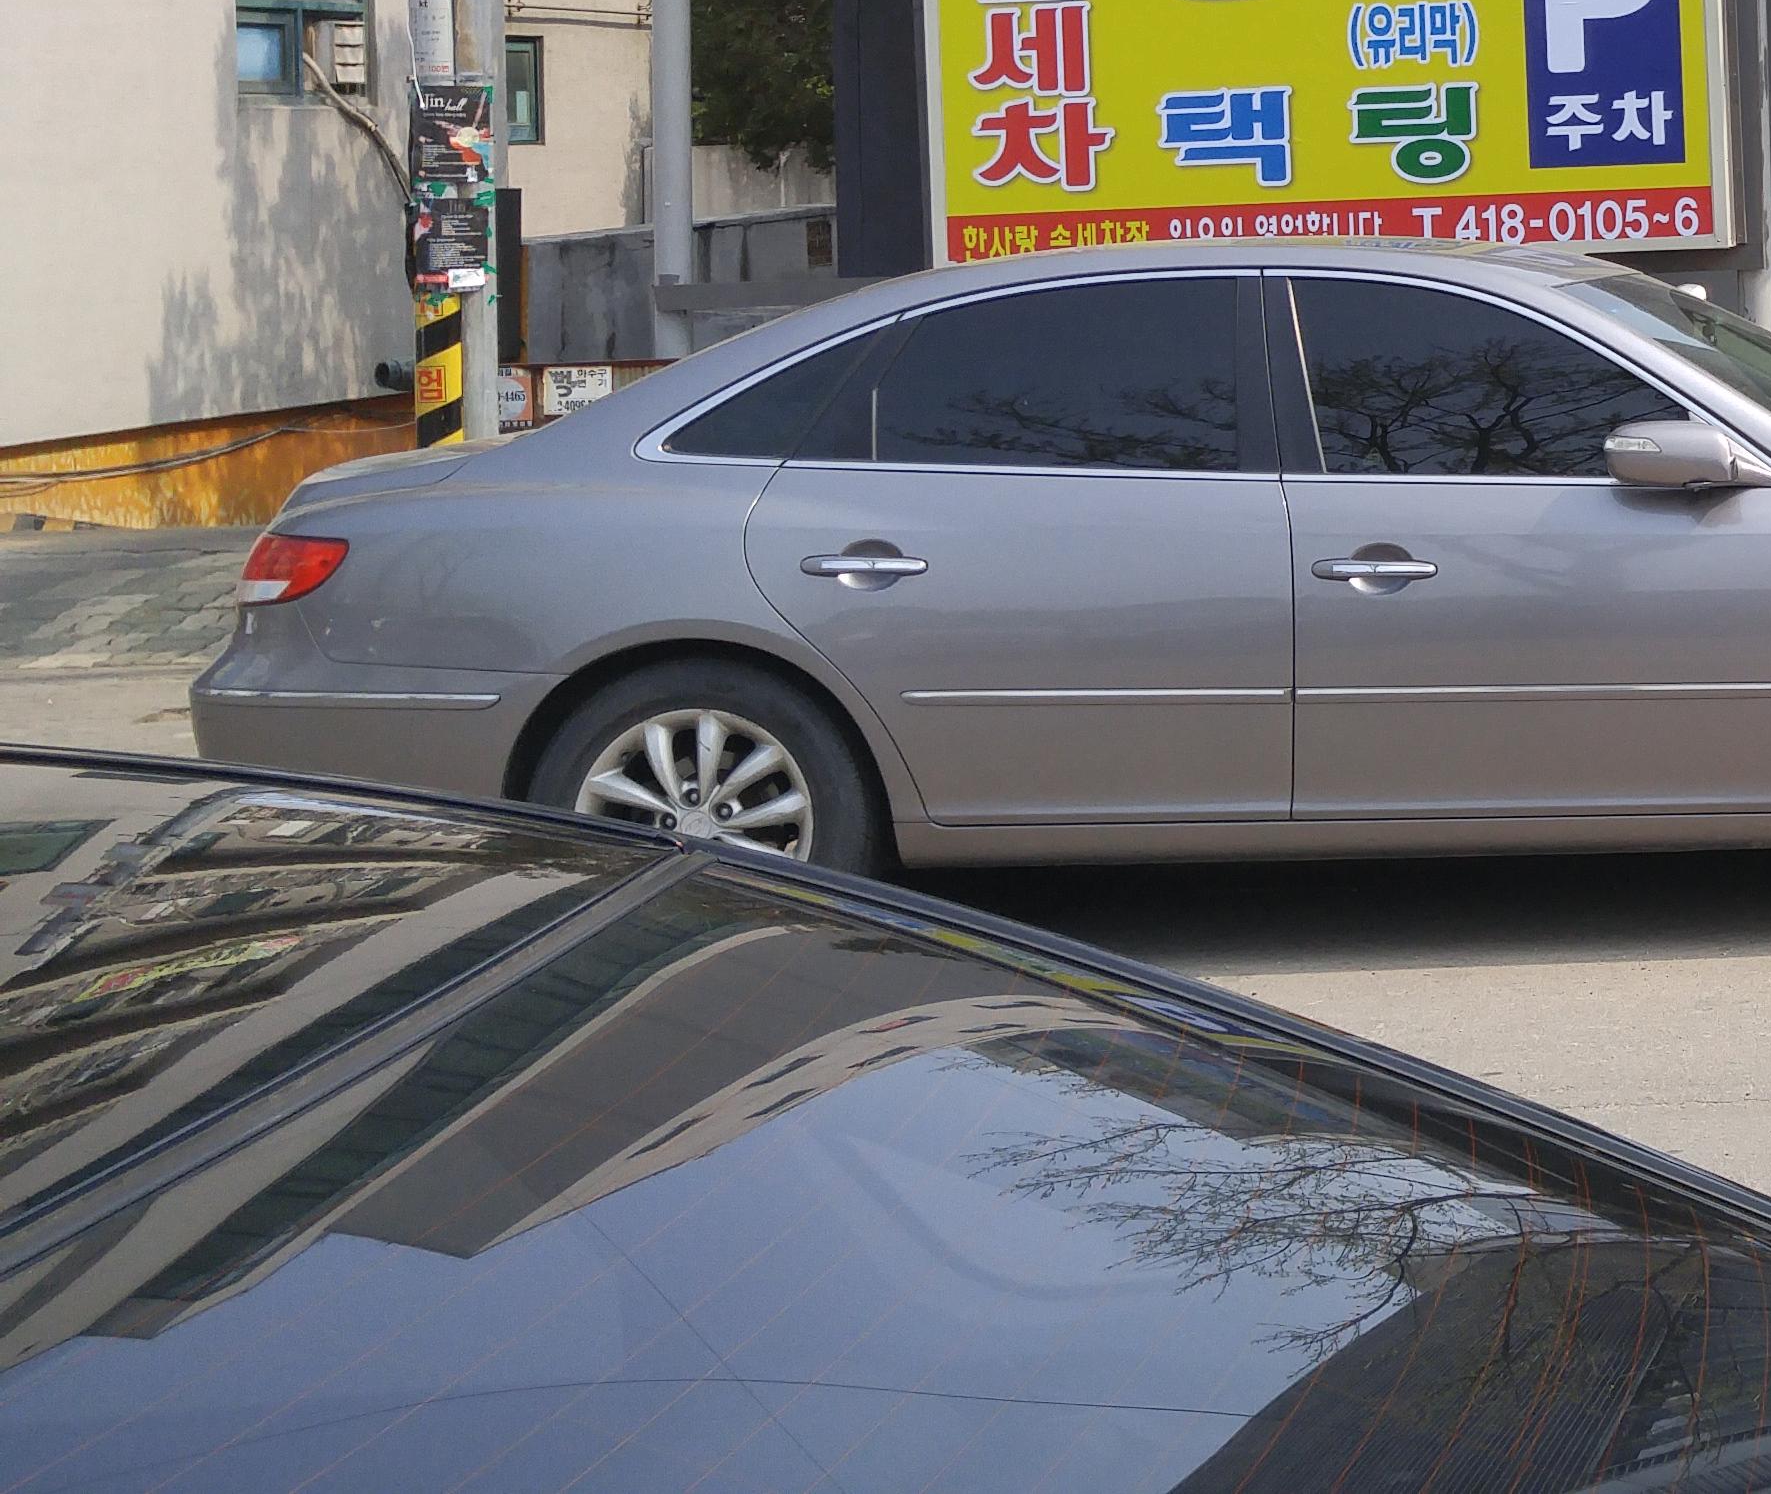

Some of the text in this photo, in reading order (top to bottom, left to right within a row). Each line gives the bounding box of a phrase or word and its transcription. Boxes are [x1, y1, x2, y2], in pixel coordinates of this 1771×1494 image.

[1346, 0, 1479, 68] (유리막)
[1545, 90, 1674, 151] 주차
[1455, 196, 1700, 245] 418-0105~6
